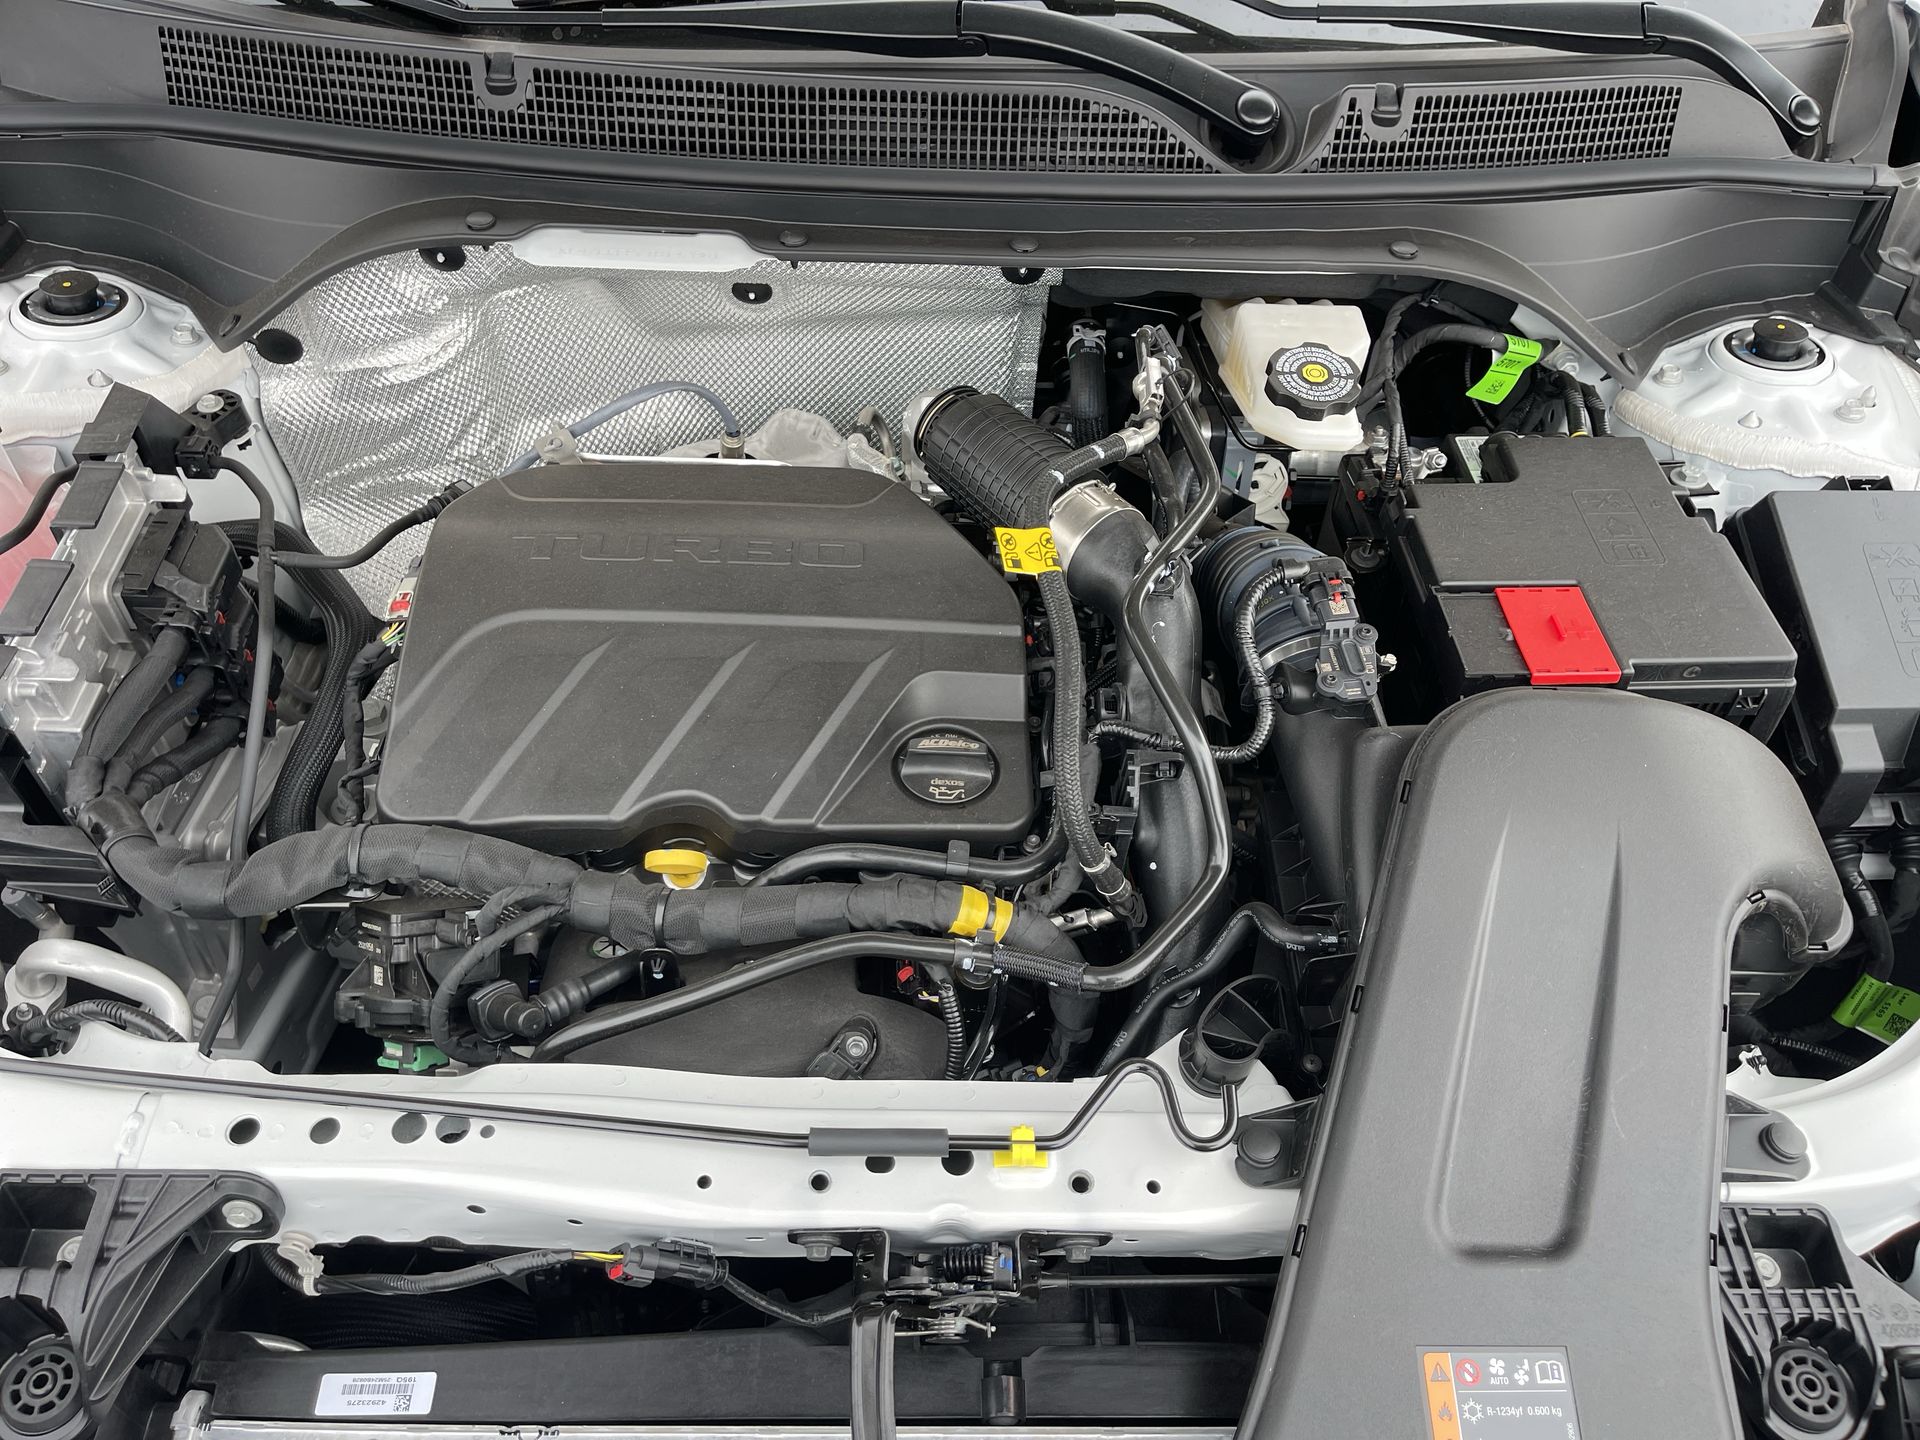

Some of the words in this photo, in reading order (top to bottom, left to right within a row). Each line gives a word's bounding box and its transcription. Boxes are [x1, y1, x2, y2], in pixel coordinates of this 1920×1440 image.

[511, 534, 865, 568] TURBO
[917, 738, 980, 749] ACDelco
[930, 778, 965, 786] dexos
[1490, 1377, 1509, 1385] AUTO
[1486, 1406, 1523, 1418] R-1234yf
[1527, 1406, 1550, 1416] 0.600
[1551, 1406, 1562, 1417] kg
